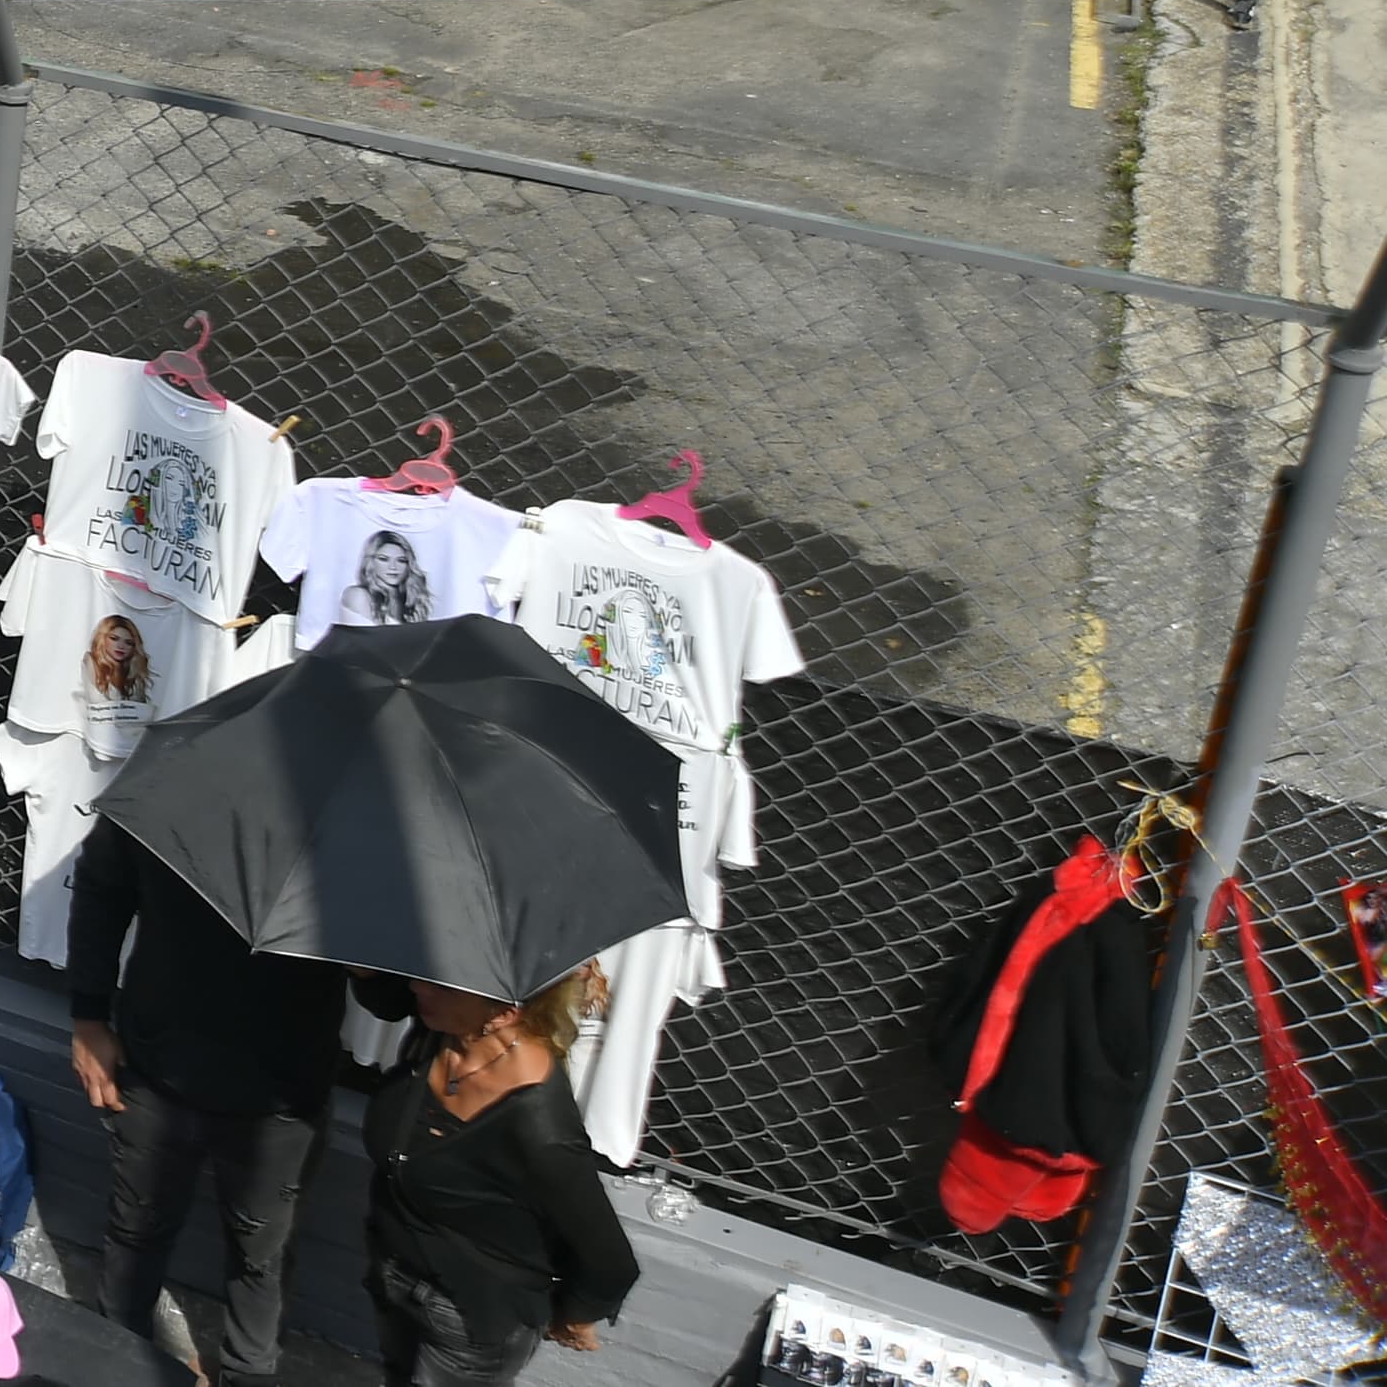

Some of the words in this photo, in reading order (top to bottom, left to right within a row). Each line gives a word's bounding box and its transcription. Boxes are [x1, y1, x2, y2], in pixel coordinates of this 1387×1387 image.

[124, 429, 148, 463] LAS
[150, 435, 200, 474] MUJERES
[200, 458, 217, 481] YA
[198, 475, 217, 500] NO
[96, 506, 124, 521] LAS
[86, 518, 223, 602] FACTURAN
[151, 527, 214, 561] MUJERES
[572, 563, 598, 598] LAS
[600, 567, 659, 605] MUJERES
[662, 591, 681, 611] YA
[660, 606, 683, 632] NO
[546, 644, 577, 661] LAS
[611, 664, 685, 699] MUJERES
